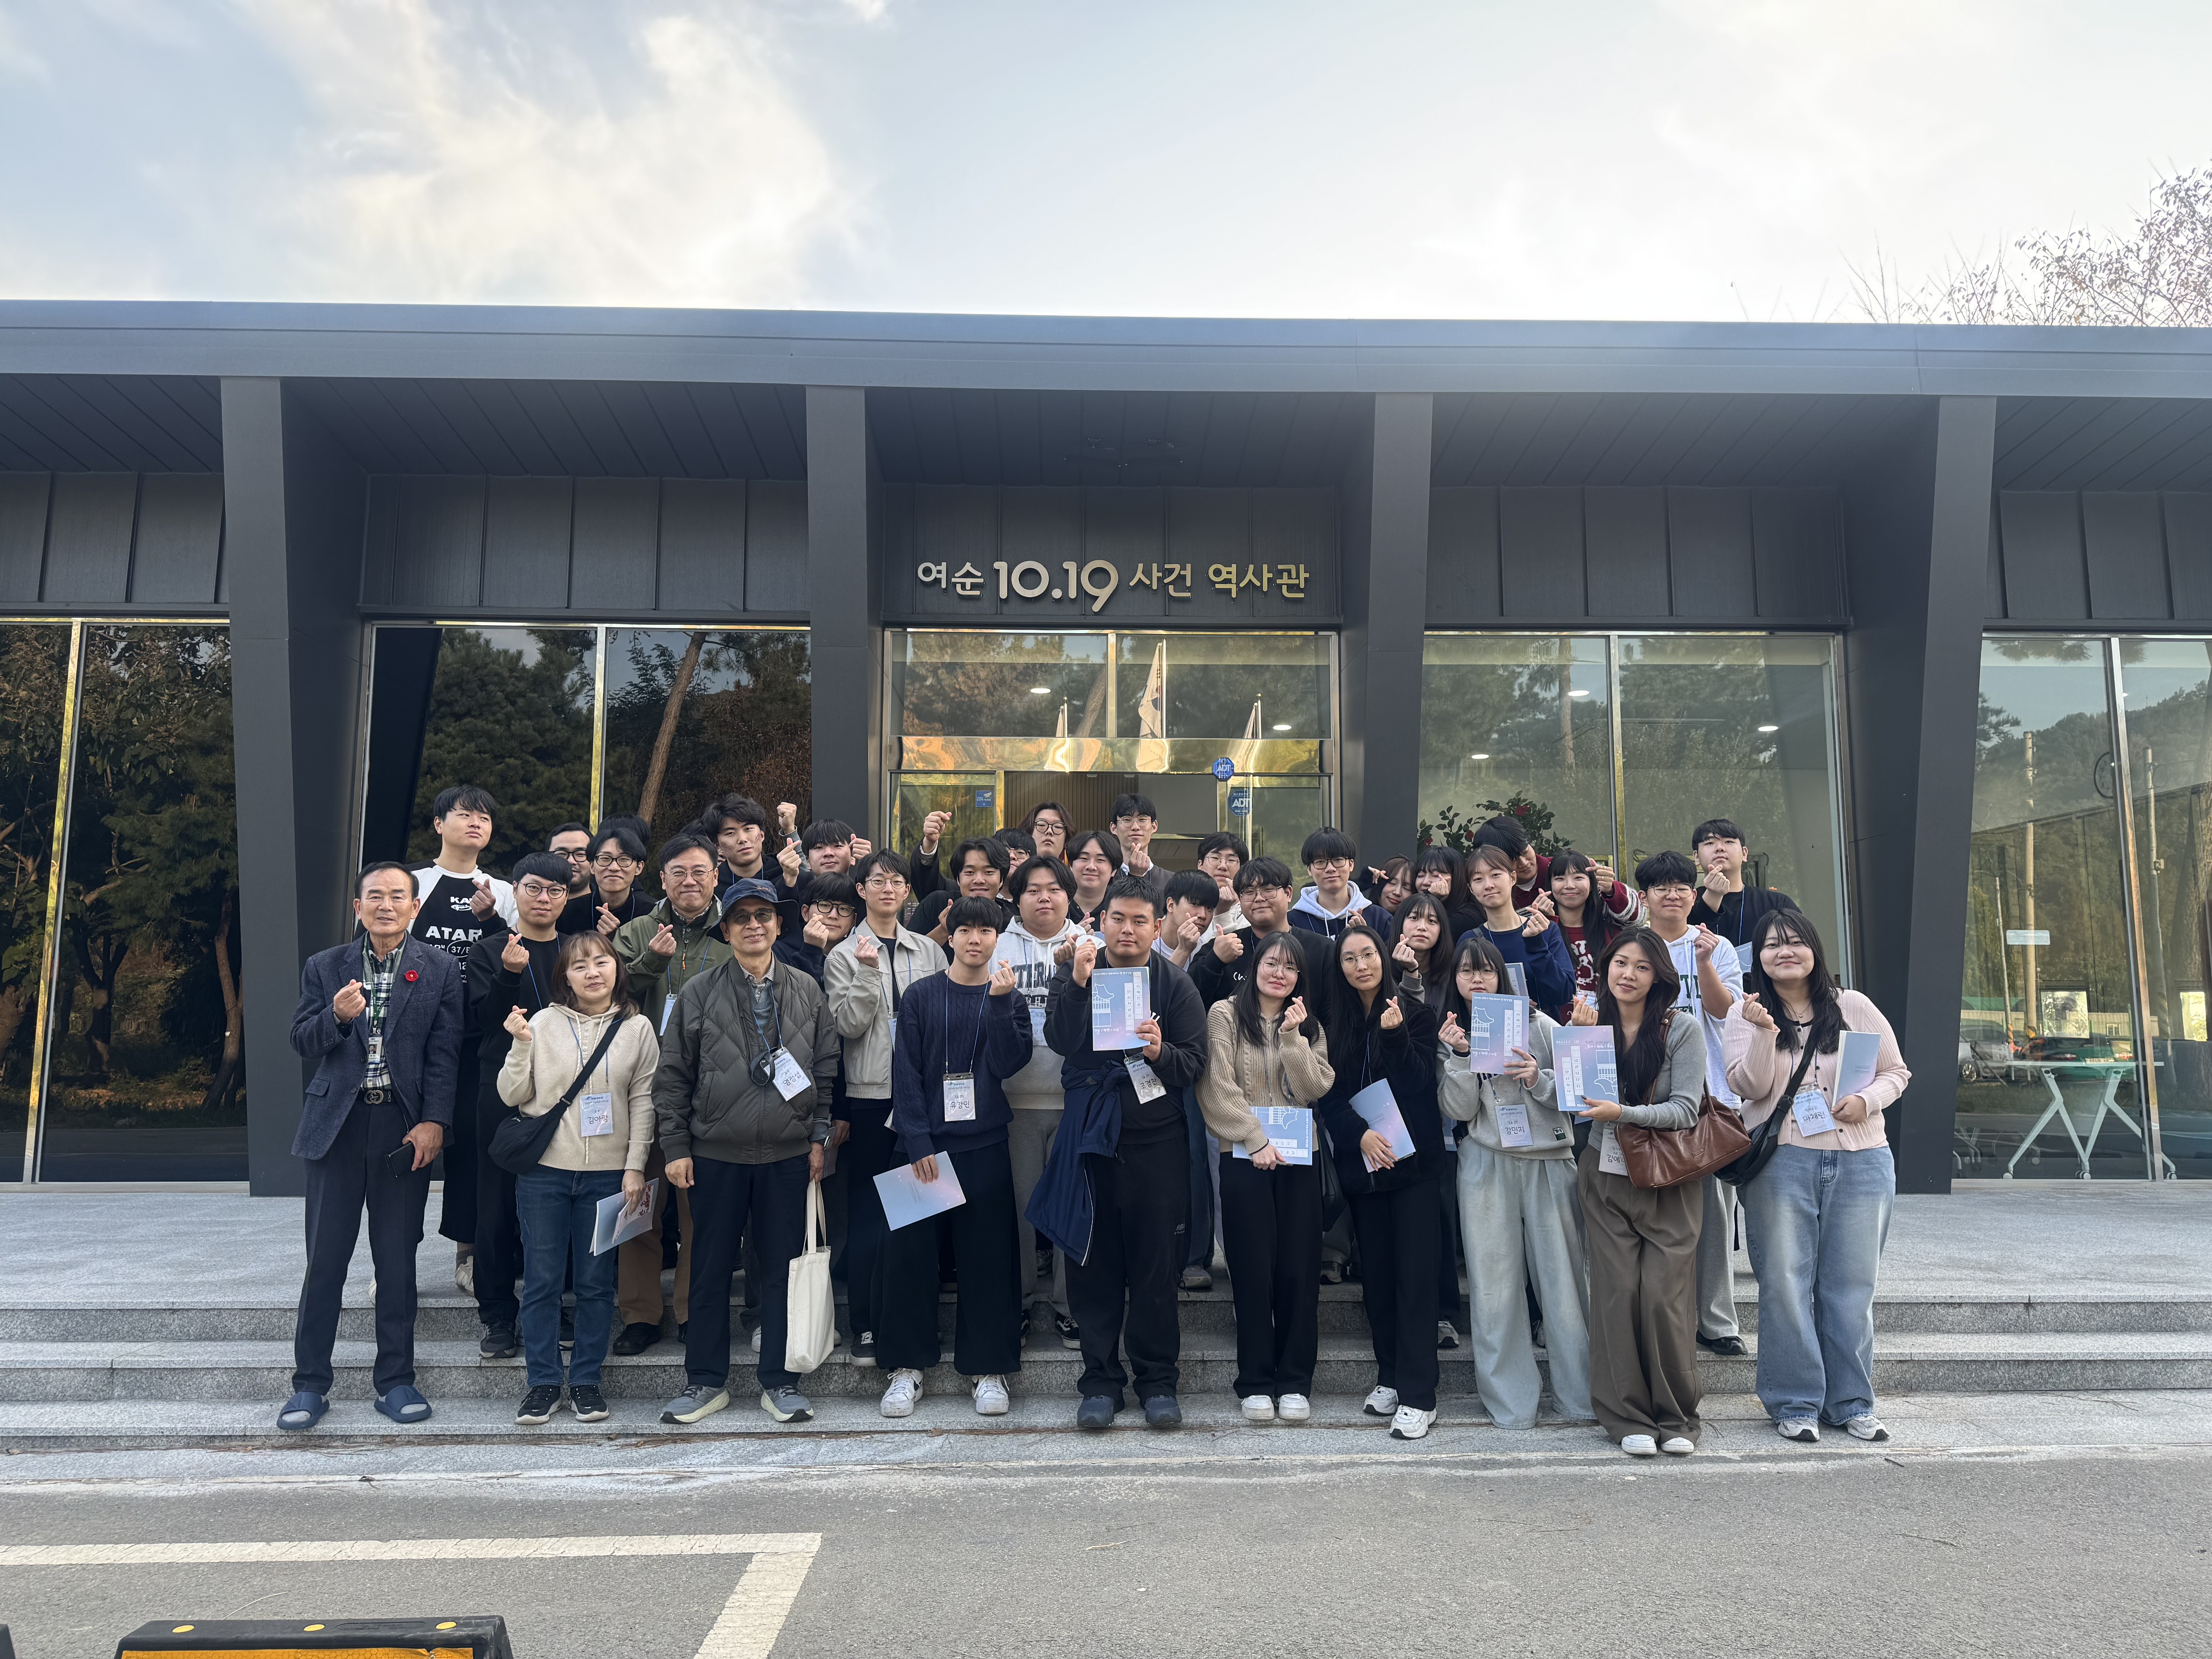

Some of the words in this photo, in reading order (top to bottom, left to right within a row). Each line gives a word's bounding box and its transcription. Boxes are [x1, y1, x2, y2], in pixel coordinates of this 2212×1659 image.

[917, 561, 984, 596] 여순
[993, 560, 1119, 613] 10.19
[1129, 563, 1192, 598] 사건
[1208, 563, 1310, 598] 역사관
[1232, 798, 1250, 807] ADT
[783, 1071, 801, 1086] 염정섭
[951, 1101, 969, 1109] 유강인
[587, 1115, 609, 1124] 김아람
[1803, 1111, 1826, 1121] 마채린
[1504, 1126, 1525, 1135] 강민지
